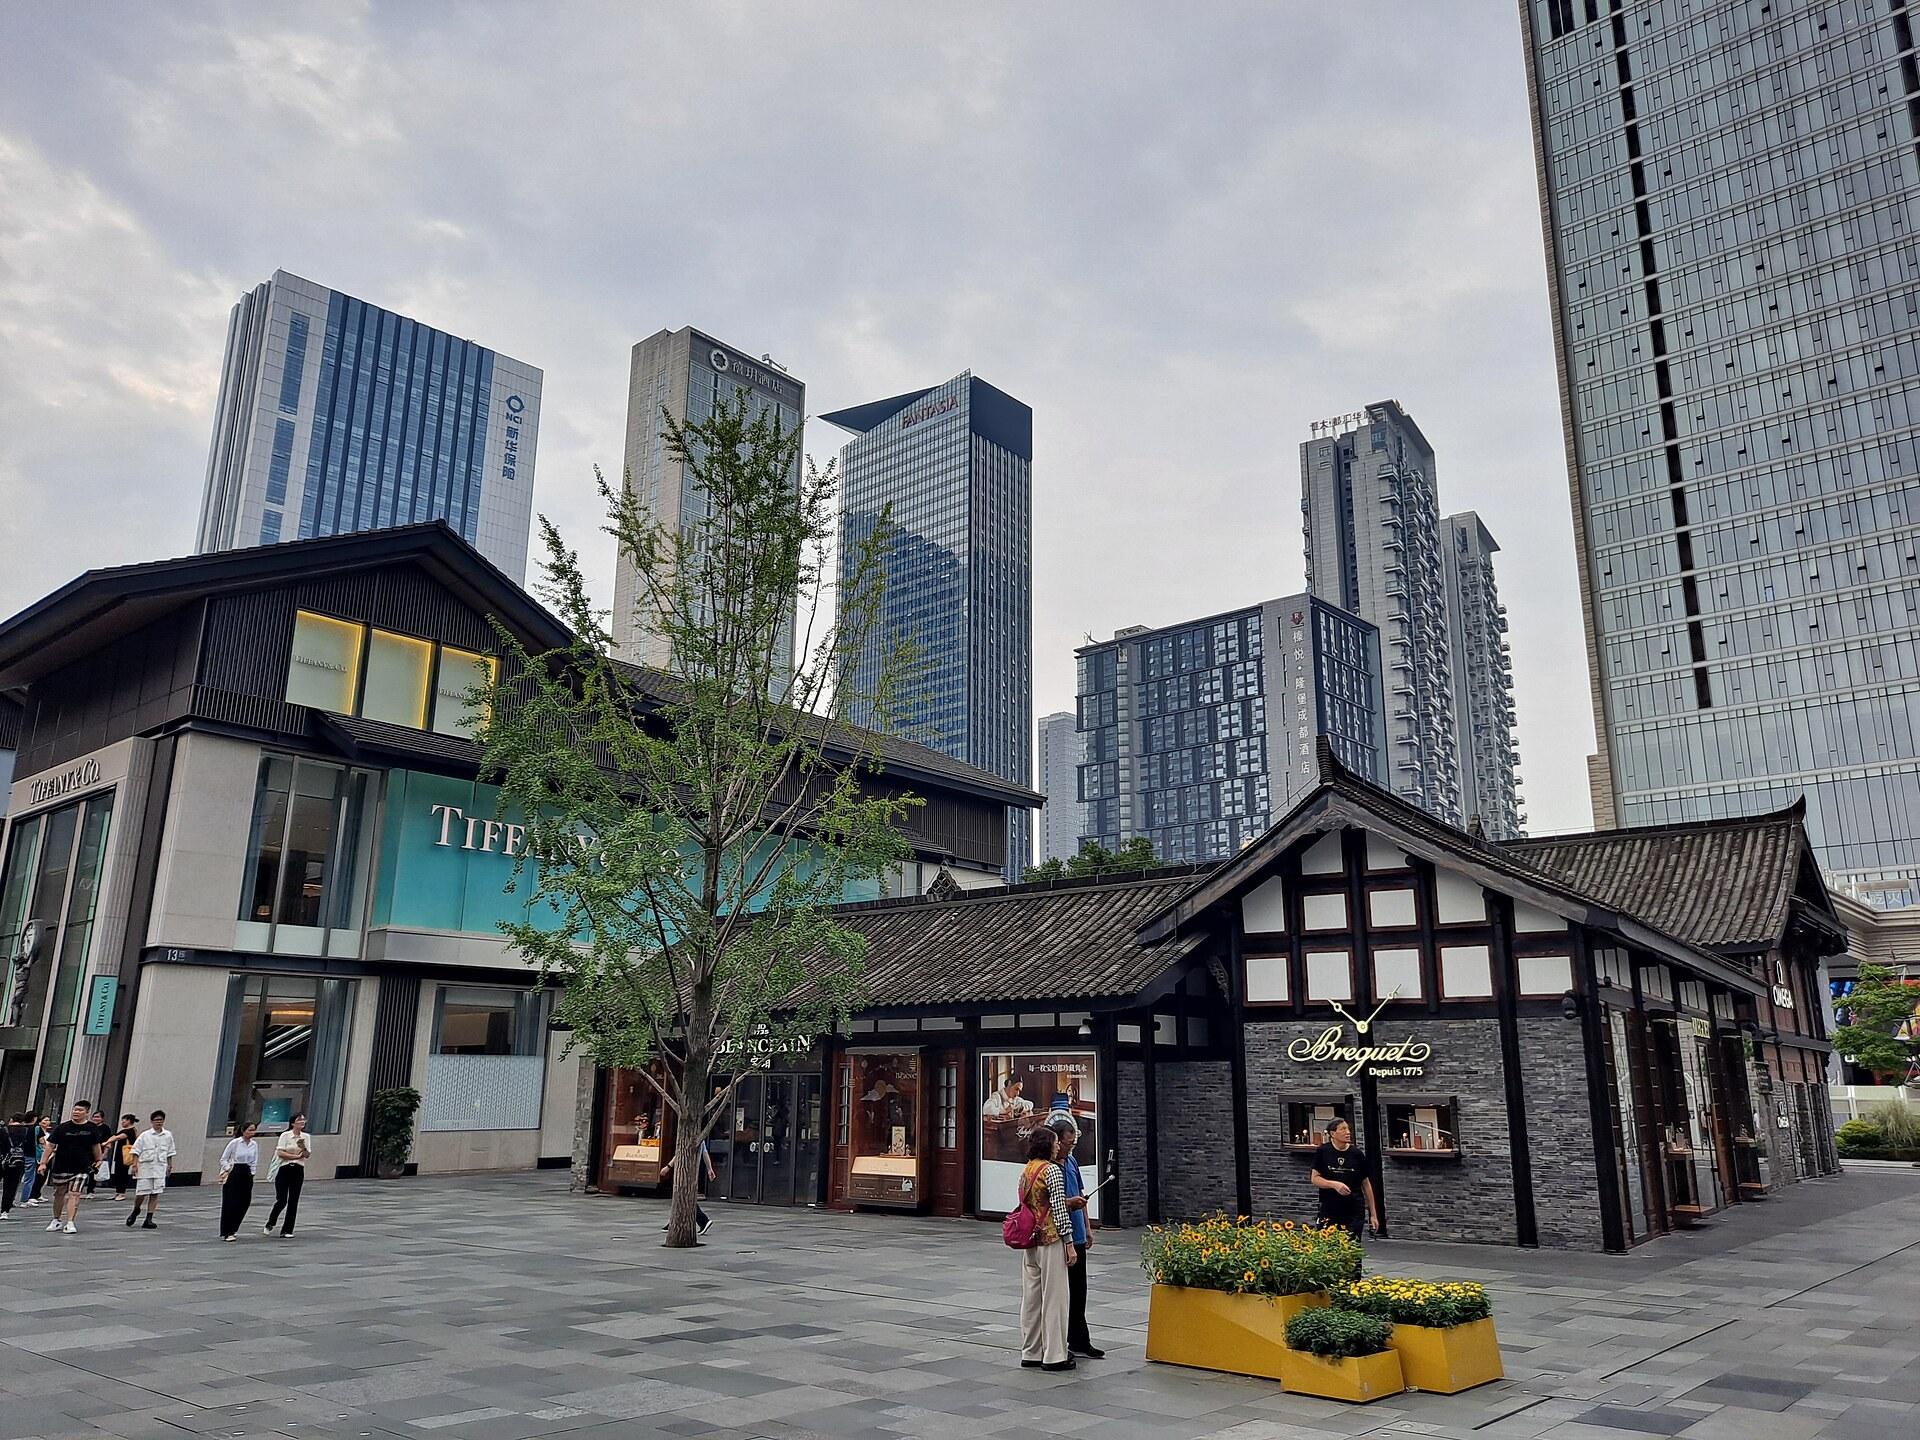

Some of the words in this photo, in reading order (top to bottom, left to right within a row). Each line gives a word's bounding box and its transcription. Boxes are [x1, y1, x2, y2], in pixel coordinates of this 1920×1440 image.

[505, 412, 523, 425] NCI
[902, 396, 959, 429] FANTASIA
[502, 425, 519, 481] 新华保险
[166, 949, 178, 961] 13
[1772, 985, 1794, 1010] OMEGA
[1287, 1024, 1431, 1077] Breguet
[1369, 1067, 1401, 1078] Depuis
[1403, 1066, 1423, 1076] 1775
